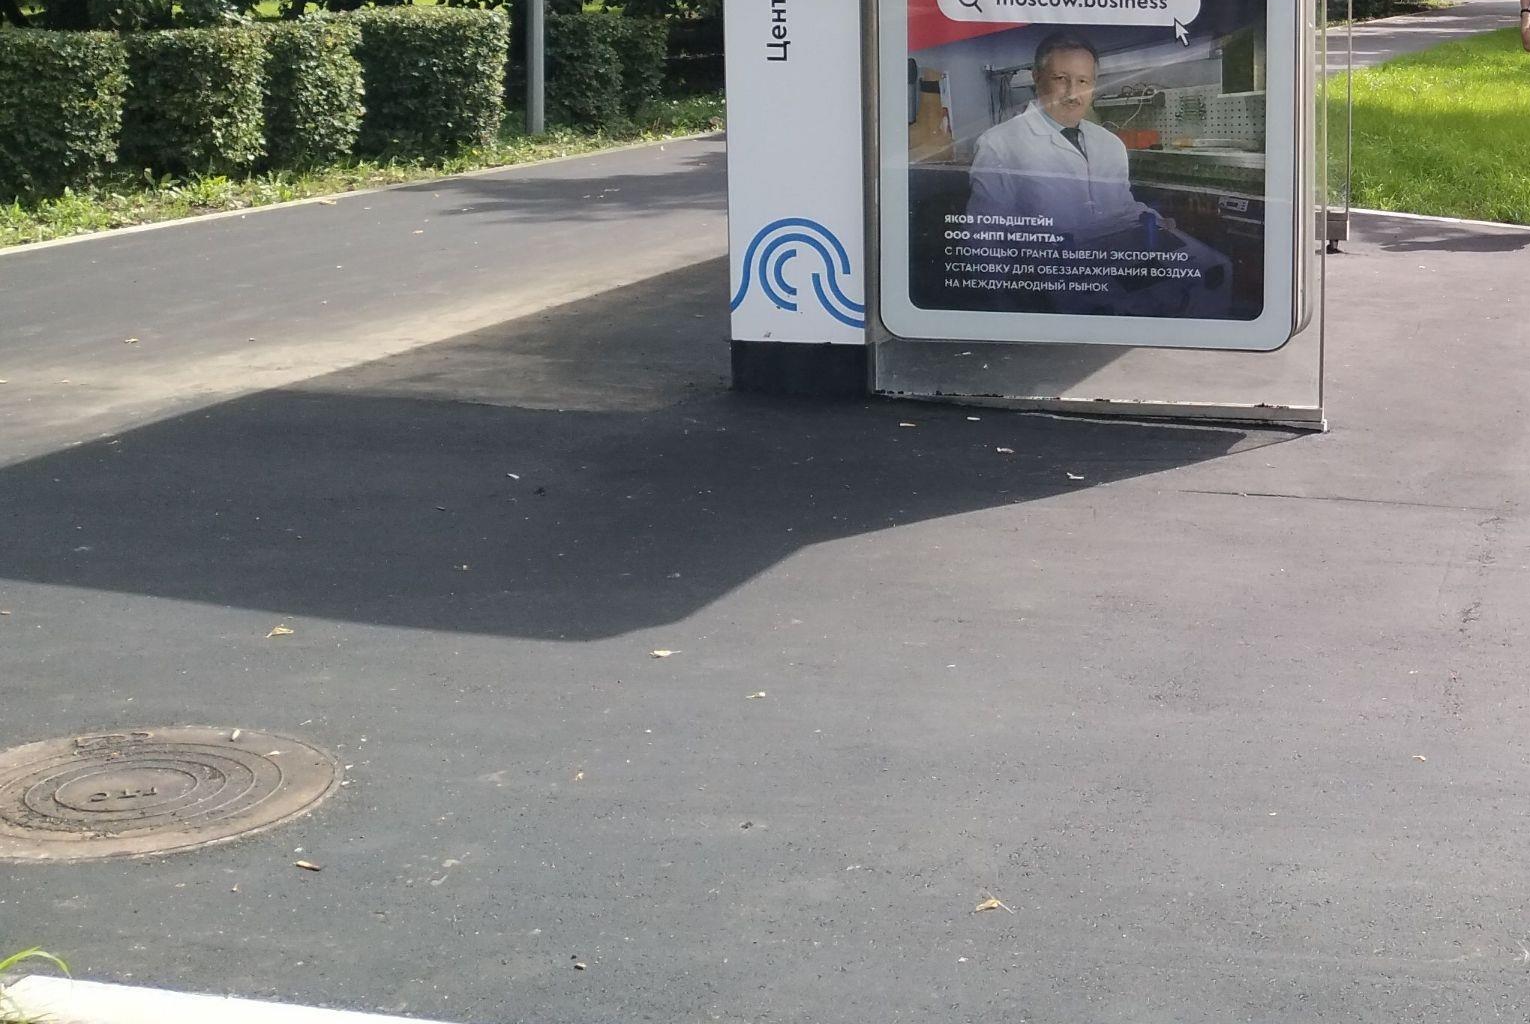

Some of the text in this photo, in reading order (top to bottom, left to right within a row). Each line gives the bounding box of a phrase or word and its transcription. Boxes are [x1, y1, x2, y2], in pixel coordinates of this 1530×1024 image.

[944, 214, 1054, 227] ЯКОВ ГОЛЬДШТЕЙН
[944, 230, 1065, 243] ООО «НПП МЕЛИТТА»
[944, 247, 1189, 262] С ПОМОЩЬЮ ГРАНТА ВЫВЕЛИ ЭКСПОРТНУЮ
[944, 262, 1202, 279] УСТАНОВКУ ДЛЯ ОБЕЗЗАРАЖИВАНИЯ ВОЗДУХА
[944, 278, 1109, 293] НА МЕЖДУНАРОДНЫЙ РЫНОК
